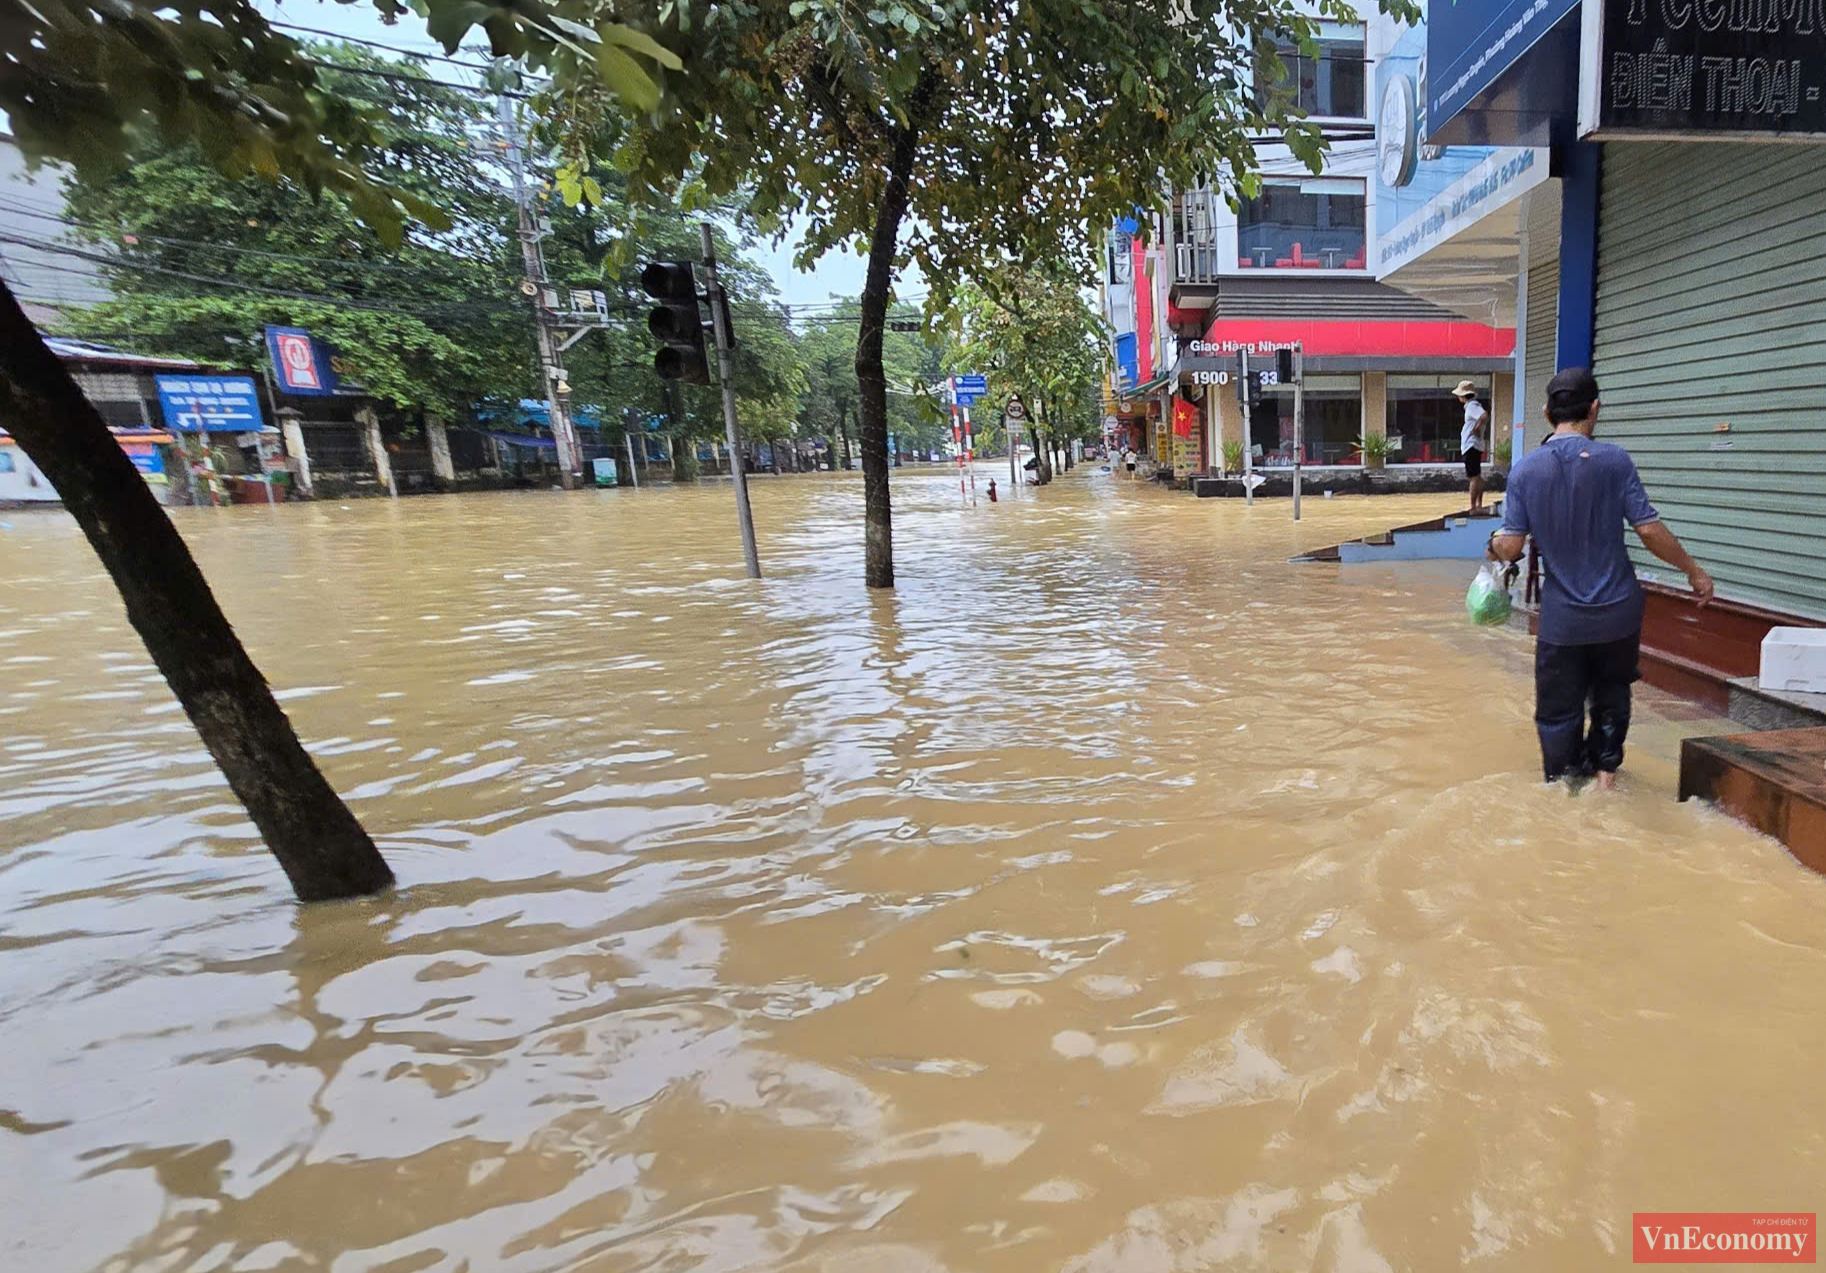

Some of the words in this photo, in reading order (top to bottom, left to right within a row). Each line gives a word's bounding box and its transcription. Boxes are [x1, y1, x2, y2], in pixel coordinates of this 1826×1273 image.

[1611, 37, 1694, 122] ĐIỆN
[1701, 56, 1801, 121] THOẠI
[1189, 340, 1220, 352] Giao
[1222, 340, 1255, 354] Hàng
[1191, 370, 1228, 385] 1900
